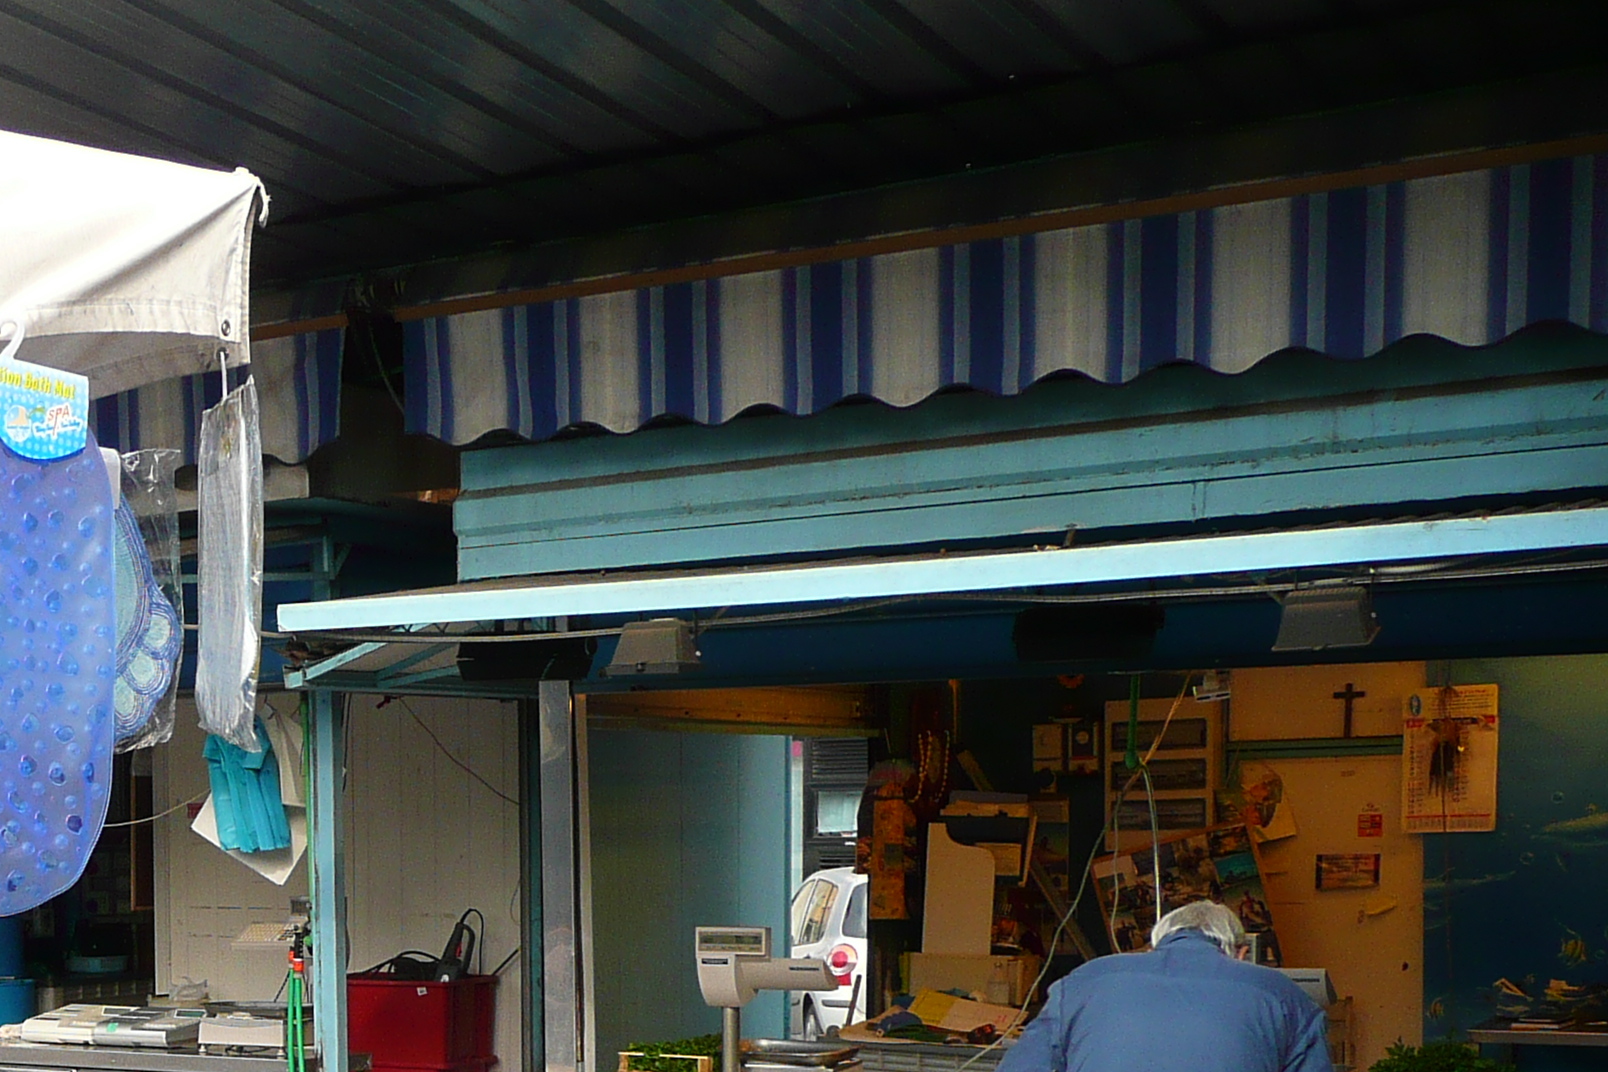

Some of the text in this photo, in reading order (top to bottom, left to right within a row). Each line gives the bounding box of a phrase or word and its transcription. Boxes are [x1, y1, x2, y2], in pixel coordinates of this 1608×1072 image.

[24, 372, 52, 394] Bath
[54, 380, 76, 400] Mat
[48, 404, 71, 437] SPA
